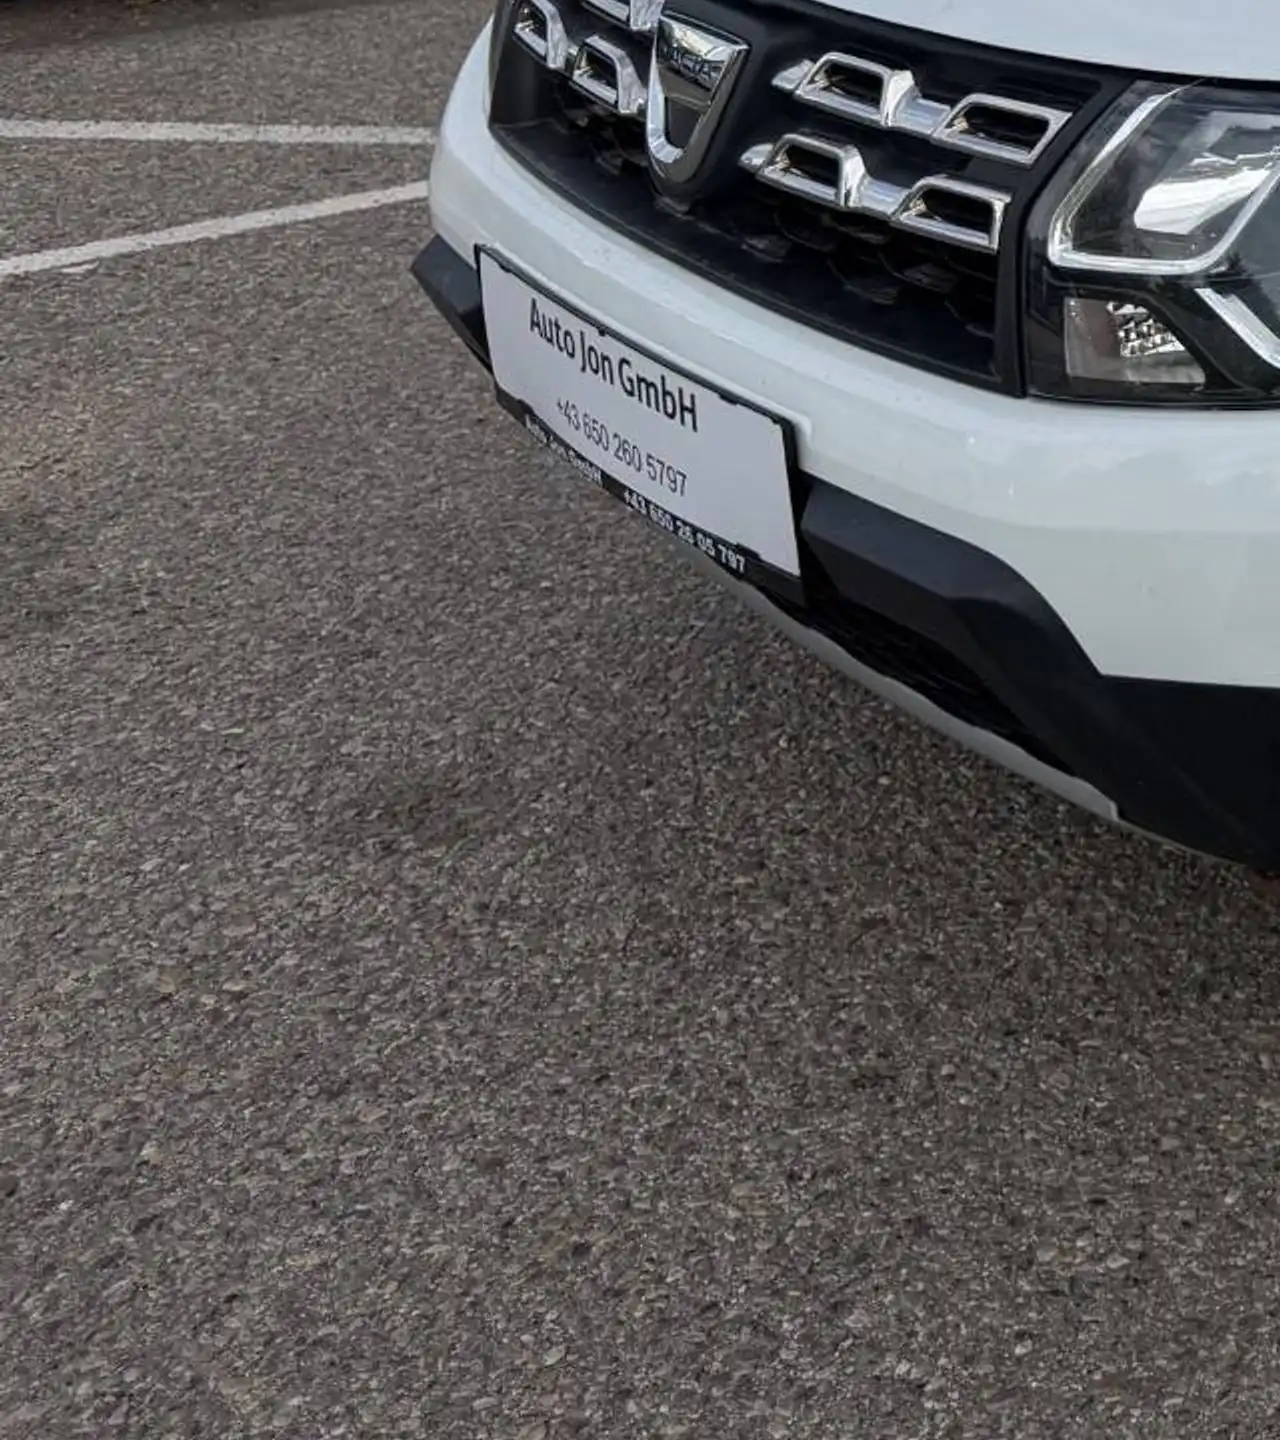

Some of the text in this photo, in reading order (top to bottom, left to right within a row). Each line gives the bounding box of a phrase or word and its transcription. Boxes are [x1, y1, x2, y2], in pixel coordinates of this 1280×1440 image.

[529, 297, 699, 433] Auto Jon GmbH
[556, 398, 687, 497] +43 650 260 5797
[717, 543, 745, 574] 797
